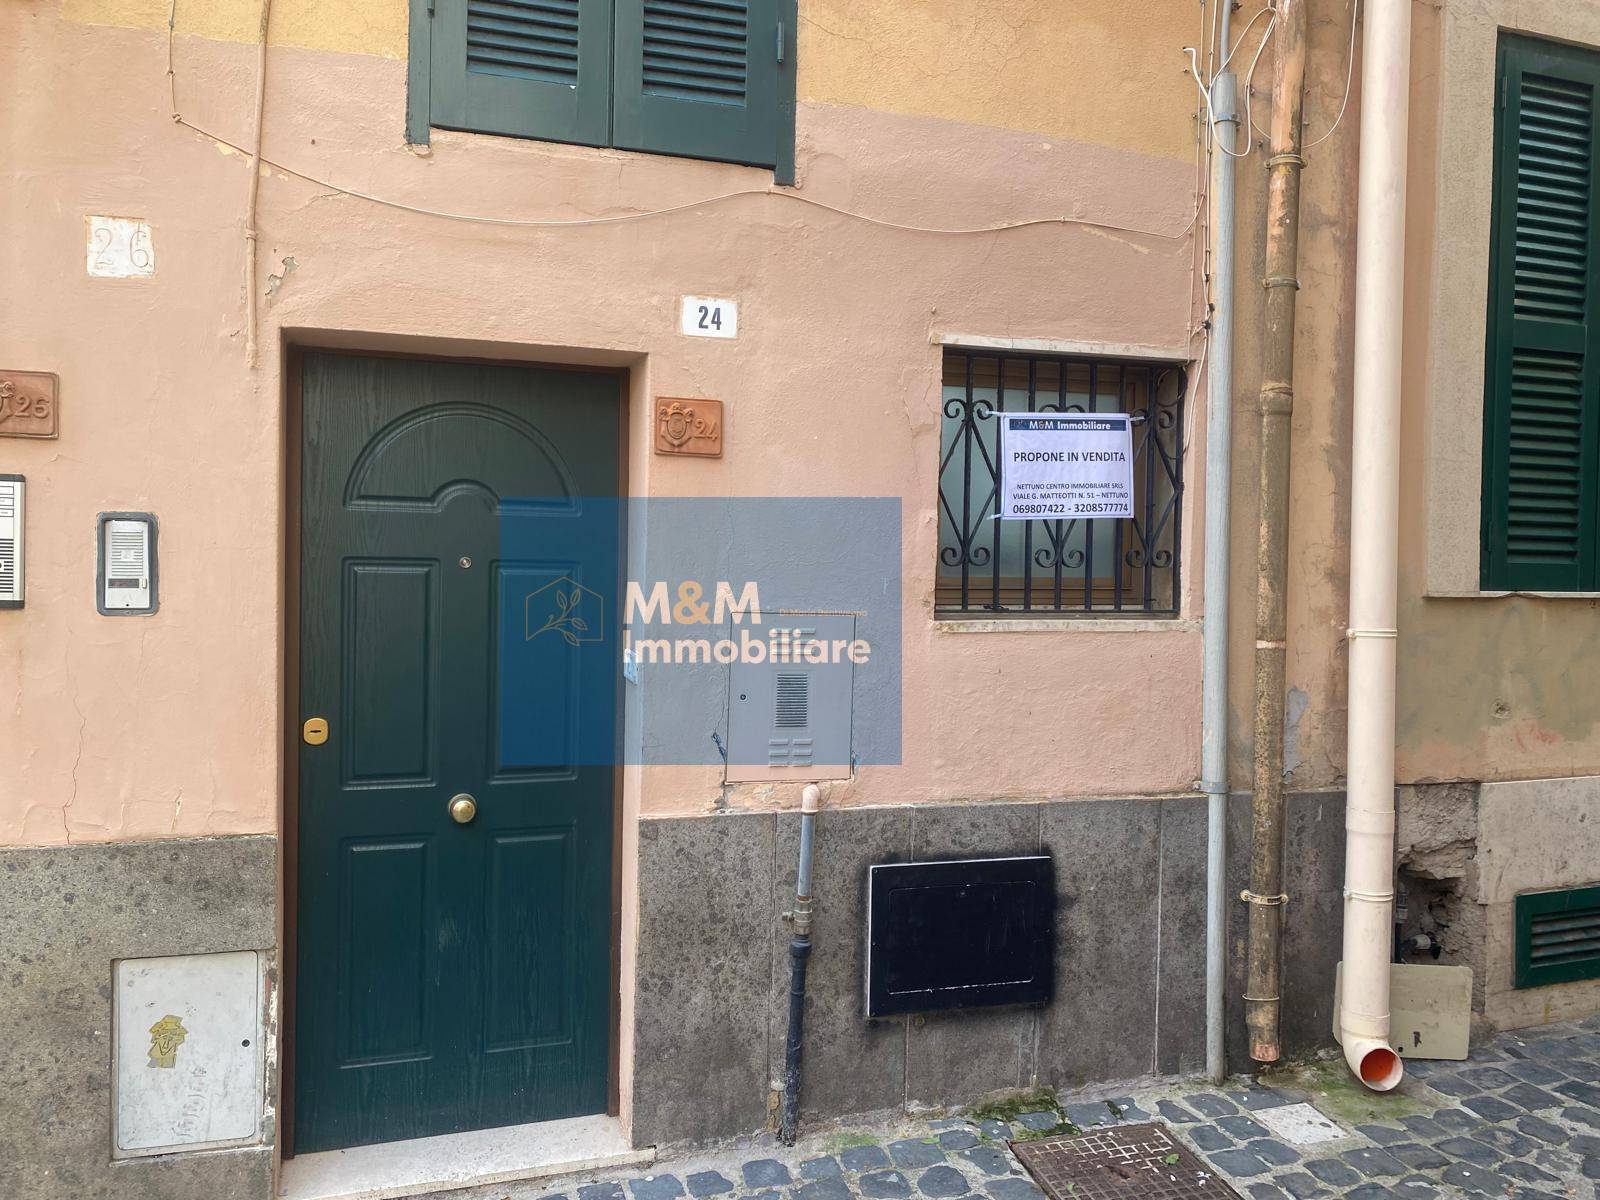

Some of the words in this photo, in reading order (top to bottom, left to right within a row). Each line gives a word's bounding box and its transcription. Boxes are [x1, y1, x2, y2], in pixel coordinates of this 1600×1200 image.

[95, 227, 149, 268] 26
[698, 306, 722, 330] 24
[694, 418, 718, 442] 24
[1029, 420, 1054, 429] M&M
[1057, 420, 1111, 430] Immobiliare
[1014, 452, 1064, 462] PROPONE
[1067, 452, 1078, 461] IN
[1082, 451, 1126, 461] VENDITA
[1013, 504, 1065, 513] 069807422
[1074, 503, 1129, 513] 3208577774
